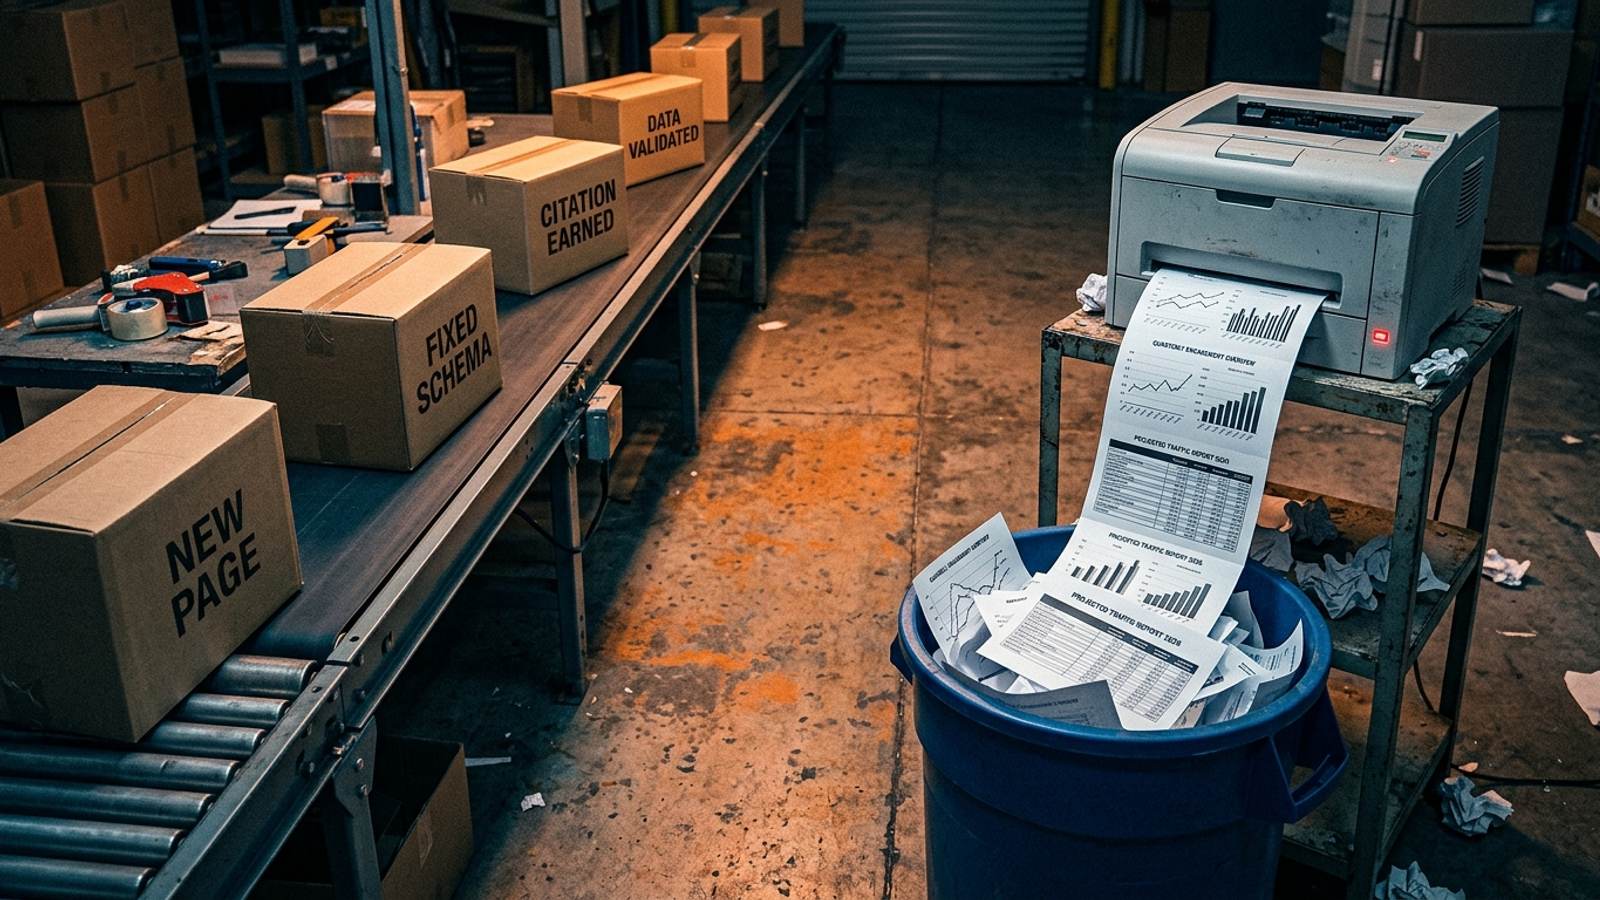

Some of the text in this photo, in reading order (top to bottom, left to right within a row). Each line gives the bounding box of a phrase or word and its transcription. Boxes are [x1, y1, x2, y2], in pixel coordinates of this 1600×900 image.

[628, 124, 699, 160] VALIDATED
[647, 108, 681, 133] DATA
[540, 179, 616, 228] CITATION
[547, 208, 615, 256] EARNED
[425, 303, 478, 367] FIXED
[416, 331, 493, 415] SCHEMA
[165, 488, 243, 585] NEW
[170, 532, 261, 639] PAGE
